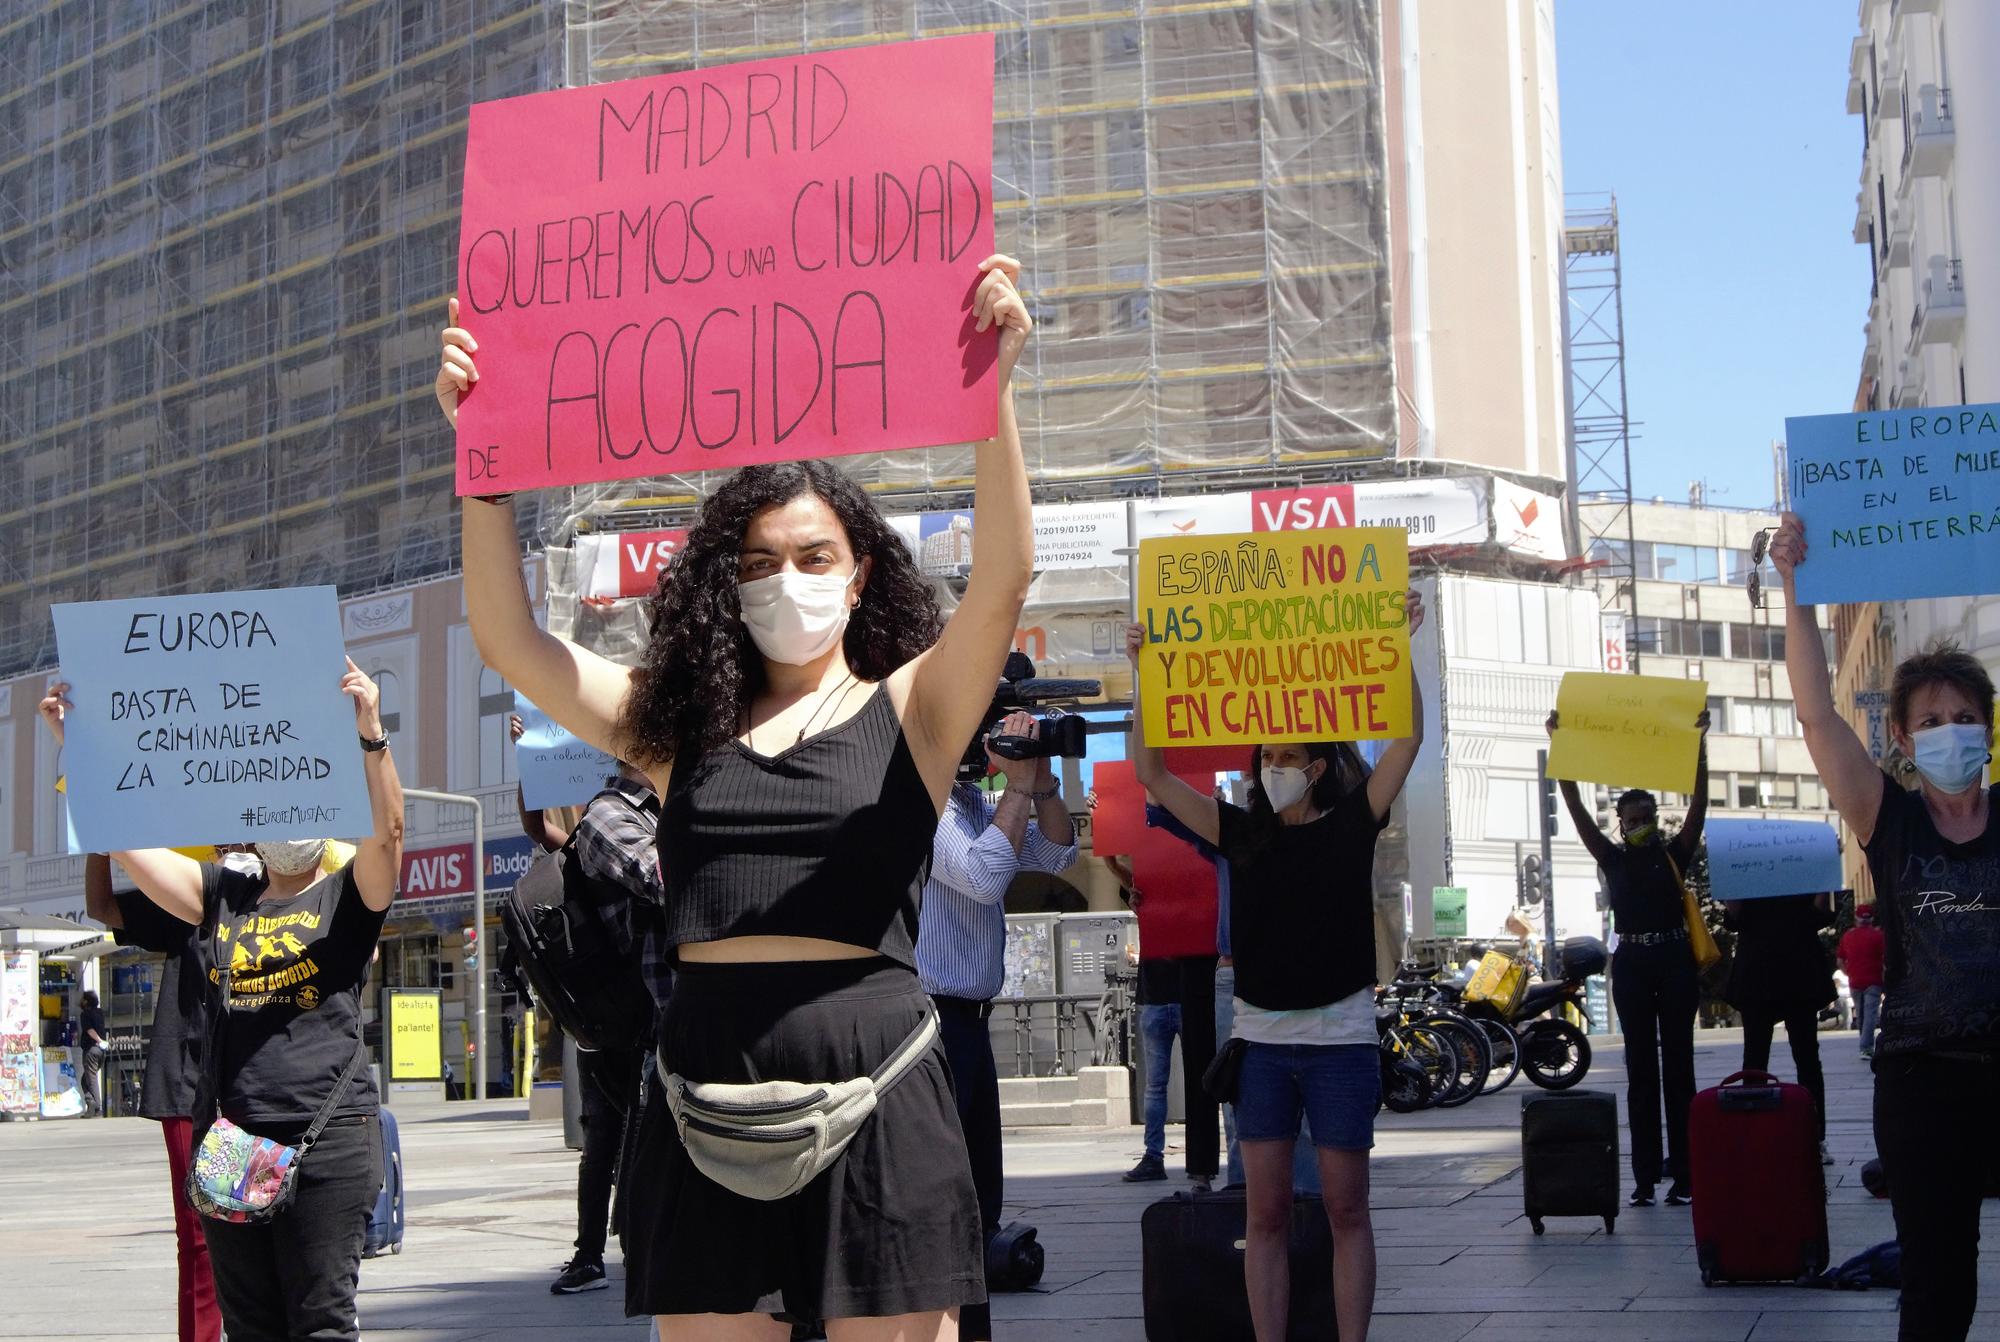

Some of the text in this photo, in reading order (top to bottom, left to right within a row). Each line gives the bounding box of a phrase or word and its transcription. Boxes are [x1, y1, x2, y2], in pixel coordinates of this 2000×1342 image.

[599, 64, 849, 182] MADRID
[466, 159, 981, 315] QUEREMOS UNA CIUDAD
[467, 290, 888, 480] DE ACOGIDA
[1857, 411, 1998, 443] EUROPA
[1903, 455, 1929, 477] DE
[1954, 449, 2000, 474] MUE
[1863, 484, 1958, 510] EN EL
[1035, 513, 1062, 524] OBRAS
[1035, 524, 1097, 536] 1/2019/01259
[1832, 506, 2000, 549] MEDITERRÁ
[626, 540, 676, 572] VS
[1034, 542, 1052, 551] ONA
[1034, 552, 1093, 564] 019/1074924
[1302, 544, 1347, 586] NO
[1355, 543, 1382, 583] A
[124, 610, 277, 654] EUROPA
[1147, 605, 1203, 644] LAS
[1208, 588, 1409, 642] DEPORTACIONES
[1158, 636, 1400, 689] Y DEVOLUCIONES
[111, 682, 262, 721] BASTA DE
[1165, 684, 1389, 739] EN CALIENTE
[137, 720, 300, 753] CRIMINALIZAR
[545, 721, 565, 739] No
[115, 756, 332, 792] LA SOLIDARIDAD
[535, 754, 547, 763] en
[406, 853, 462, 893] AVIS
[493, 852, 533, 877] Budg
[1912, 890, 1985, 916] Ronda
[268, 958, 320, 991] ACOGIDA
